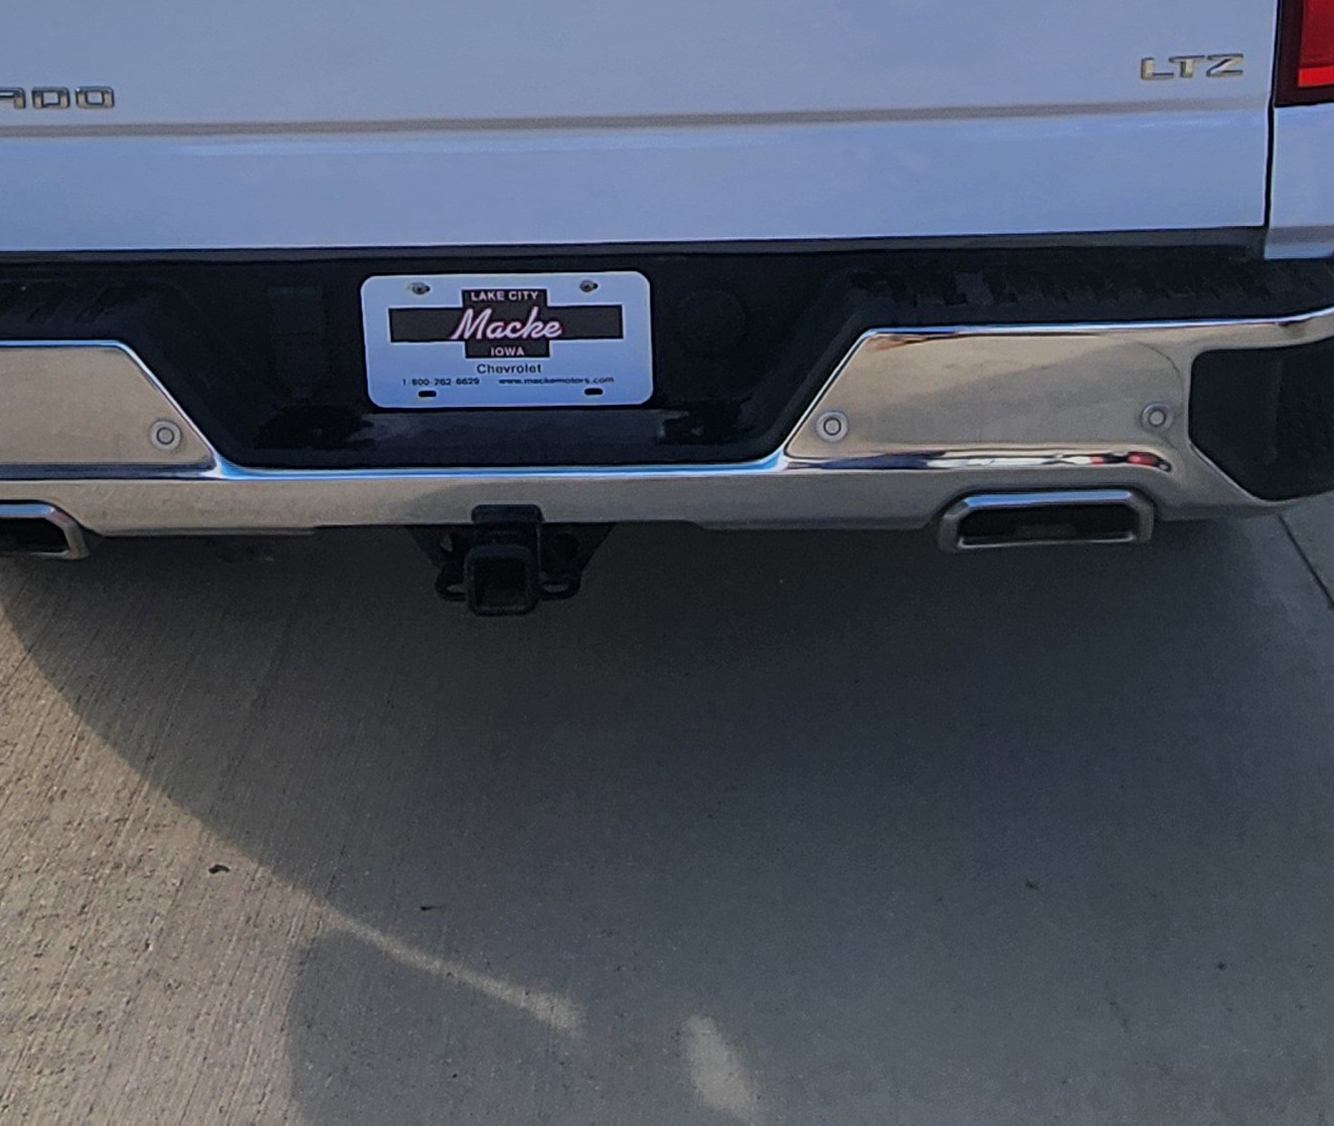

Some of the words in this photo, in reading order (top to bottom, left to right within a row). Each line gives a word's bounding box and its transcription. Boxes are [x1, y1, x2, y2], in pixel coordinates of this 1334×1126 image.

[1140, 53, 1244, 80] LTZ
[471, 291, 505, 301] LAKE
[508, 290, 539, 301] CITY
[449, 306, 563, 341] Macke
[490, 346, 525, 357] IOWA
[476, 363, 542, 375] Chevrolet
